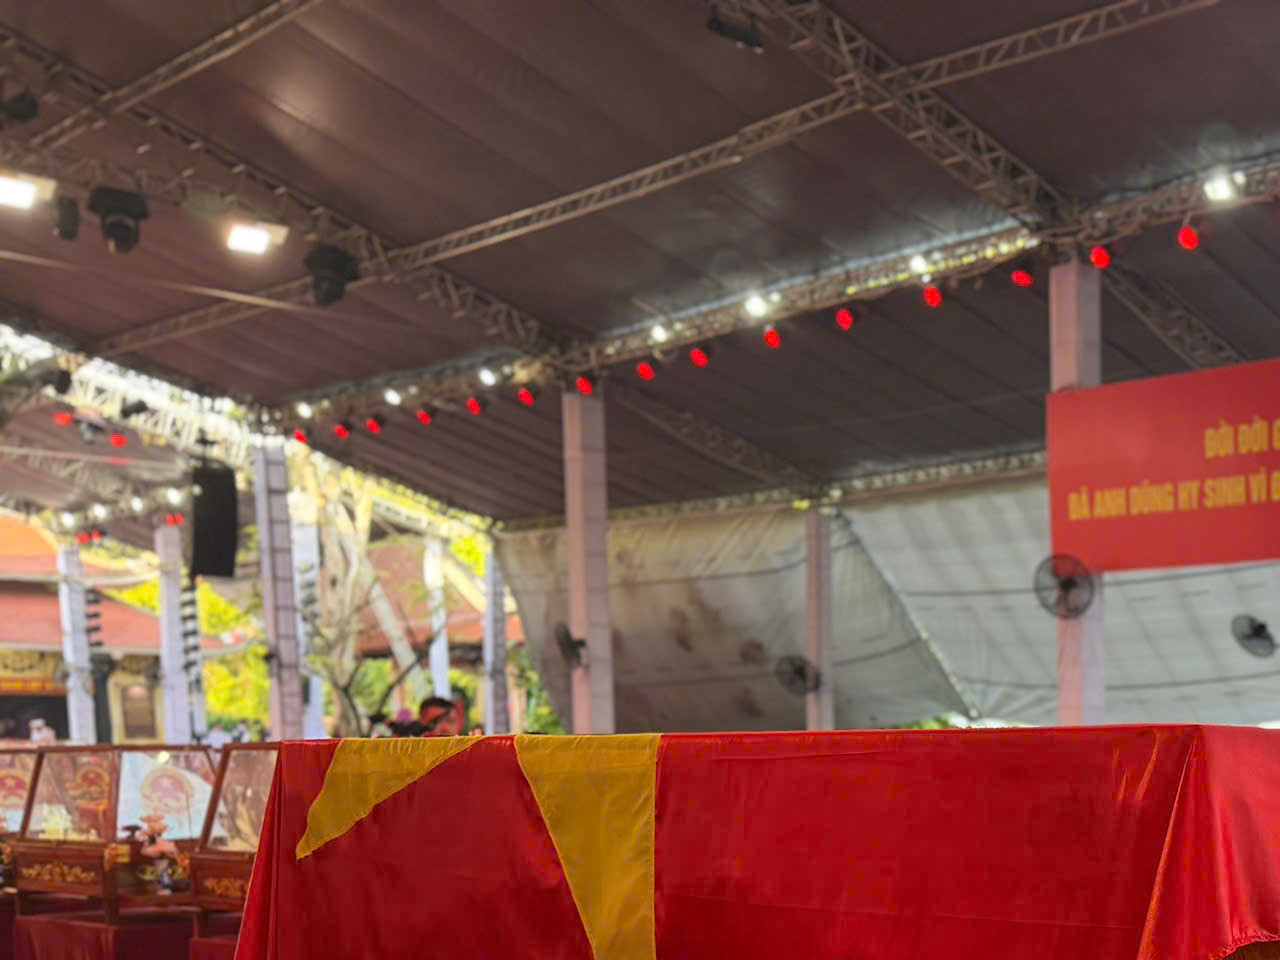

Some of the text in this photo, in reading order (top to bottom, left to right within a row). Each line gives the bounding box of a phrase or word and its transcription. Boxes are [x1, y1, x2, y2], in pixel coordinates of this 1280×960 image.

[1204, 418, 1234, 459] ĐỜI
[1238, 416, 1269, 455] ĐỜI
[1093, 488, 1126, 519] ANH
[1204, 475, 1246, 509] SINH
[1249, 466, 1267, 503] VÌ
